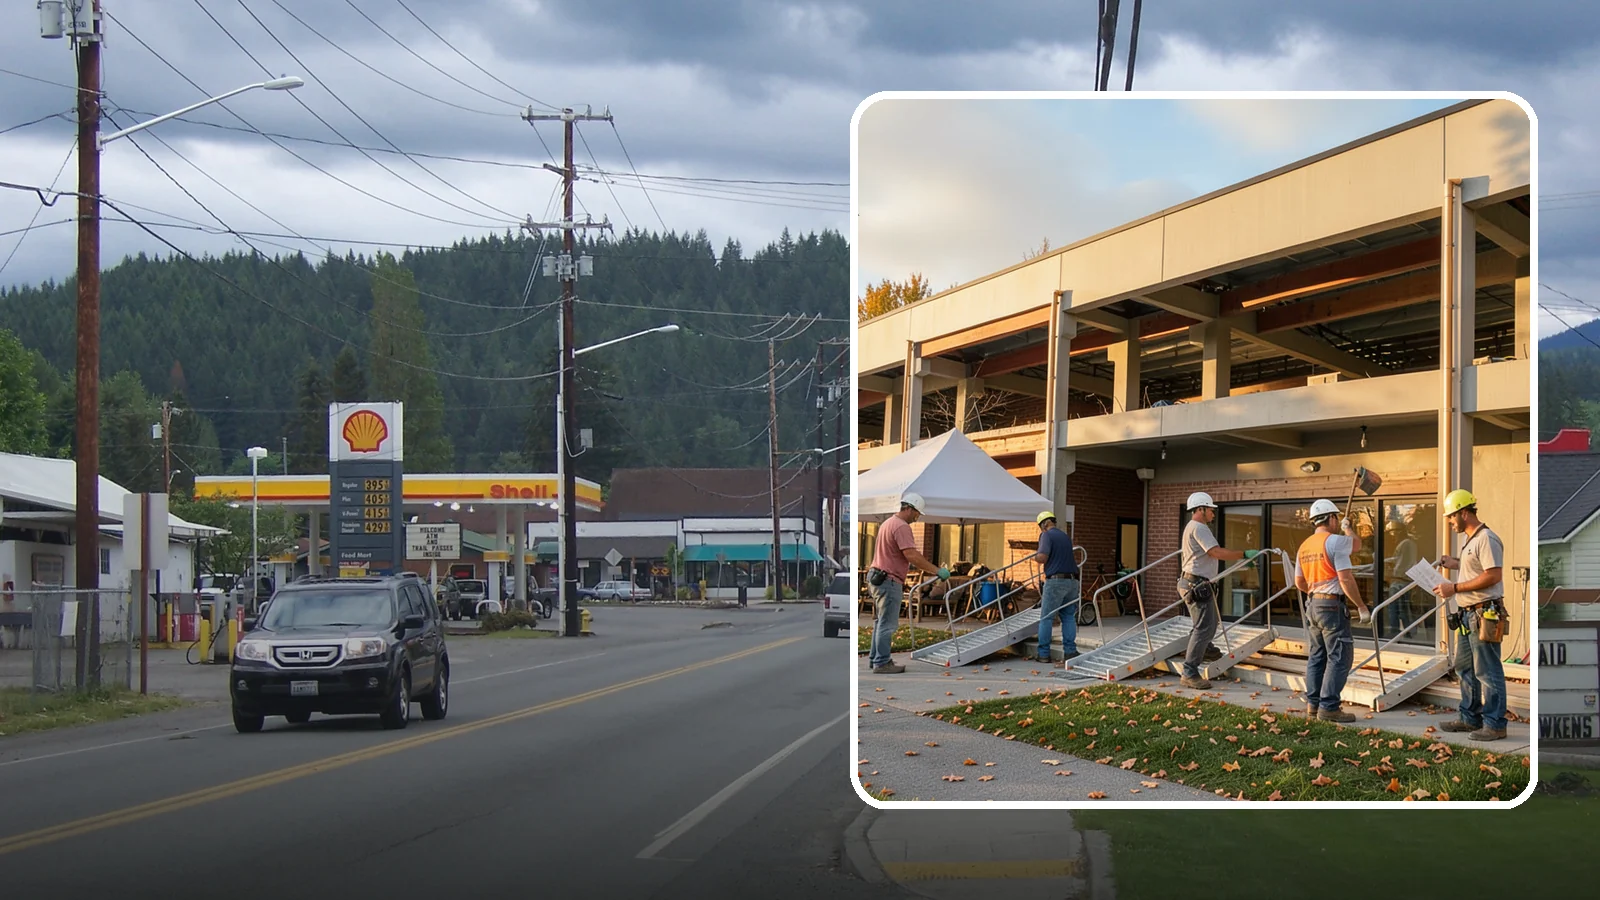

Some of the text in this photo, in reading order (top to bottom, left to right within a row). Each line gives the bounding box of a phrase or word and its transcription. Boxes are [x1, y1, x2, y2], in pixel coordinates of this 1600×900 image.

[366, 480, 383, 490] 395
[490, 484, 547, 499] Shell
[366, 494, 383, 504] 405
[366, 508, 383, 518] 415
[366, 522, 383, 532] 429
[1538, 642, 1567, 666] AID
[1538, 716, 1592, 739] WKENS
